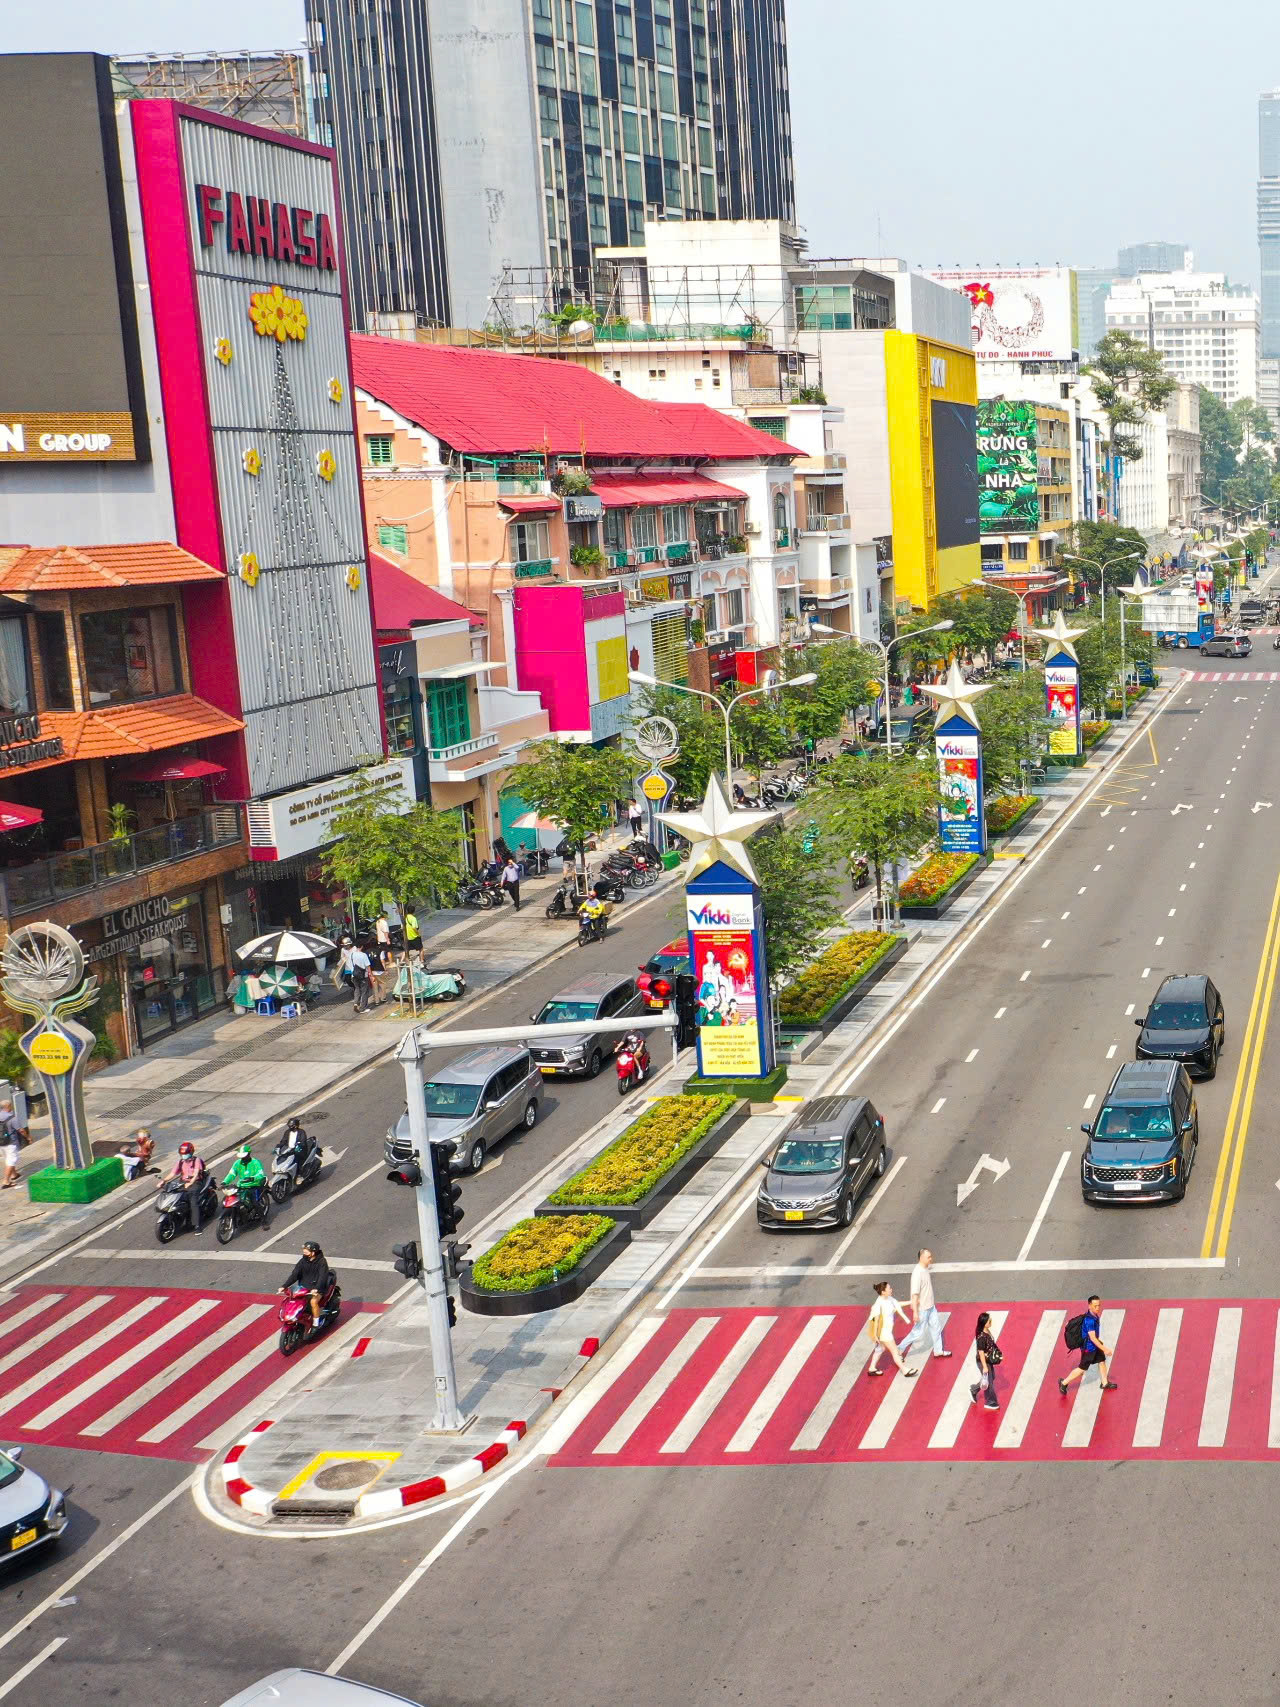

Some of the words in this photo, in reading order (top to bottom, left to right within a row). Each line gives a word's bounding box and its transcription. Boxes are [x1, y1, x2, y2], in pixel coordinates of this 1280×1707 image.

[195, 184, 338, 271] FAHASA
[39, 433, 111, 452] GROUP
[980, 433, 1028, 451] RỪNG
[985, 470, 1023, 488] NHÀ
[673, 574, 689, 585] TISSOT
[1047, 672, 1066, 682] Vikki
[938, 741, 964, 756] Vikki
[306, 800, 314, 809] TY
[103, 914, 119, 937] EL
[122, 896, 169, 930] GAUCHO
[689, 902, 730, 925] Vikki
[140, 914, 187, 945] STEAKHOUSE
